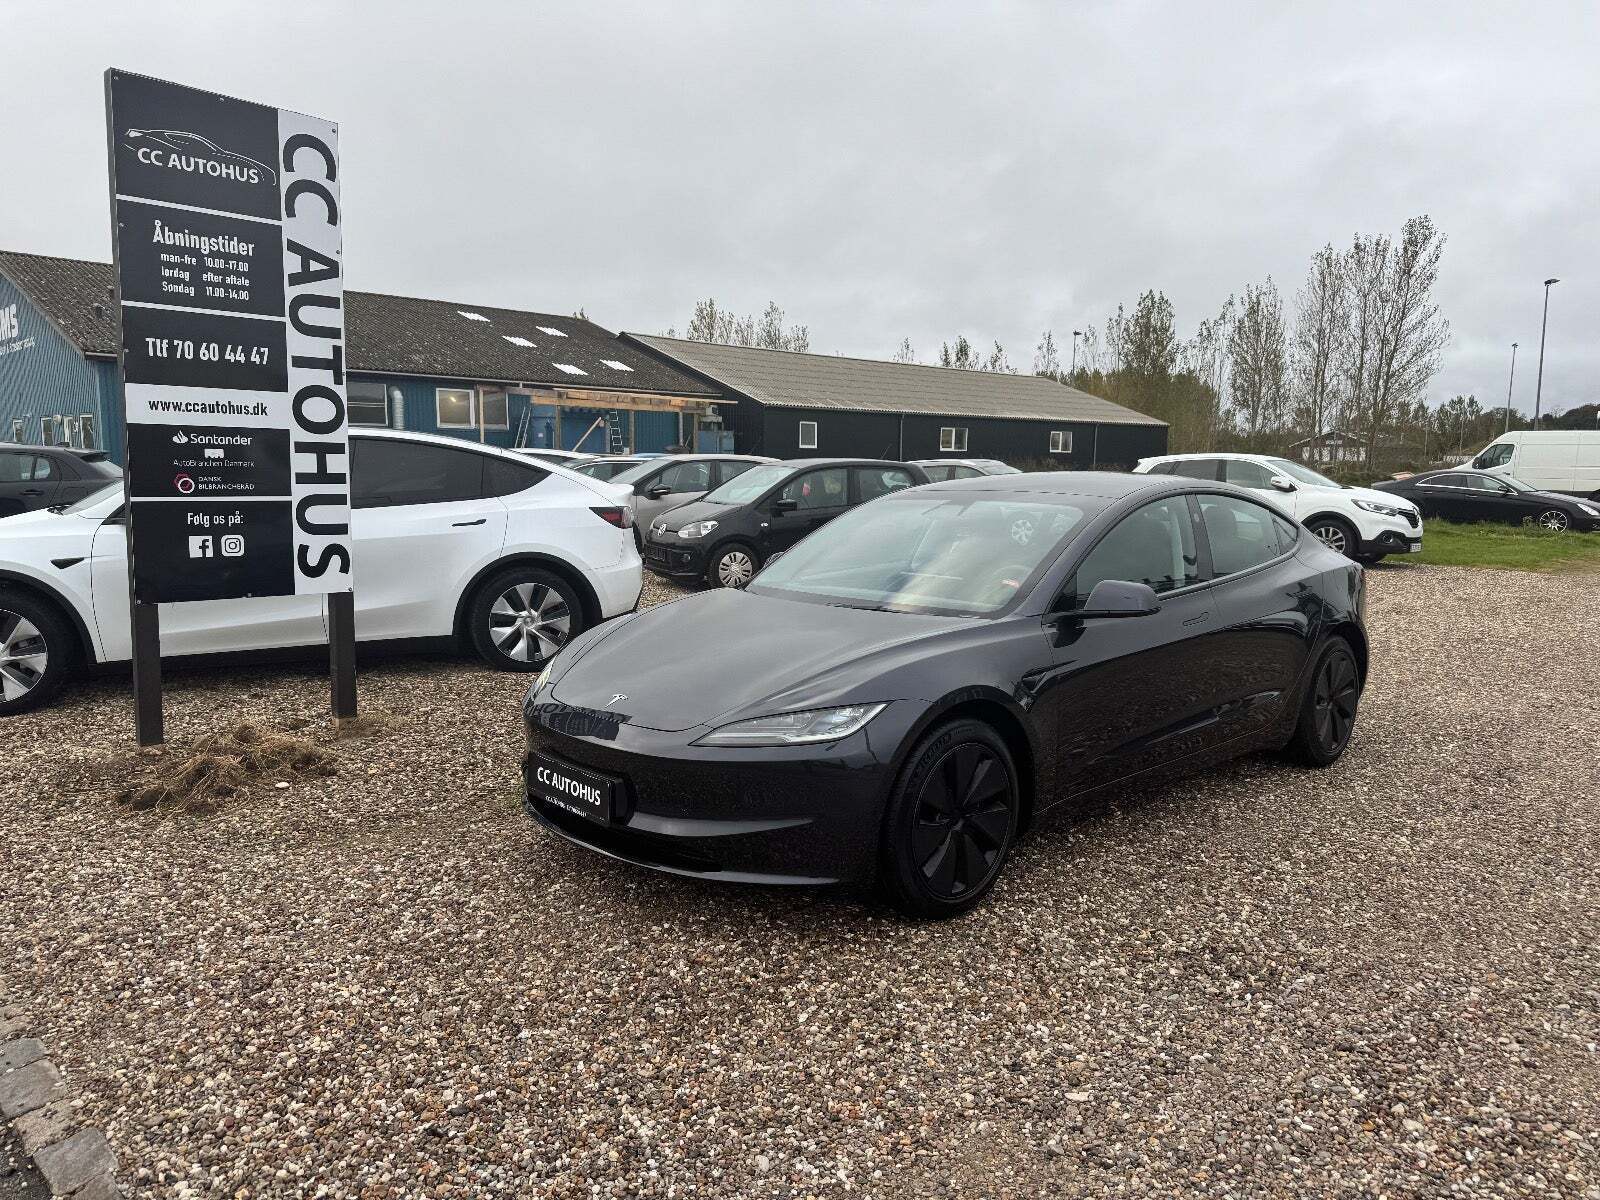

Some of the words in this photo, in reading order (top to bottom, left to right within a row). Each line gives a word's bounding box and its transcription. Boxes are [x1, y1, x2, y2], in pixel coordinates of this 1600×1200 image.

[137, 148, 162, 164] CC
[167, 153, 259, 184] AUTOHUS
[283, 133, 338, 227] CC
[152, 219, 255, 256] Åbningstider
[160, 253, 197, 265] man-fre
[203, 257, 249, 272] 10.00-17.00
[202, 272, 223, 283] efter
[225, 275, 250, 286] aftale
[162, 281, 195, 297] Søndag
[205, 286, 249, 300] 11.00-14.00
[145, 337, 169, 358] Tlf
[173, 339, 194, 359] 70
[199, 343, 219, 362] 60
[225, 345, 245, 363] 44
[250, 347, 269, 365] 47
[148, 400, 268, 416] www.ccautohus.dk
[286, 238, 351, 579] AUTOHUS
[190, 433, 252, 445] Santander
[198, 482, 255, 490] BILBRANCHERÅD
[187, 512, 210, 527] Følg
[213, 514, 225, 525] os
[228, 511, 244, 526] på:
[537, 766, 551, 785] CC
[551, 772, 601, 806] AUTOHUS
